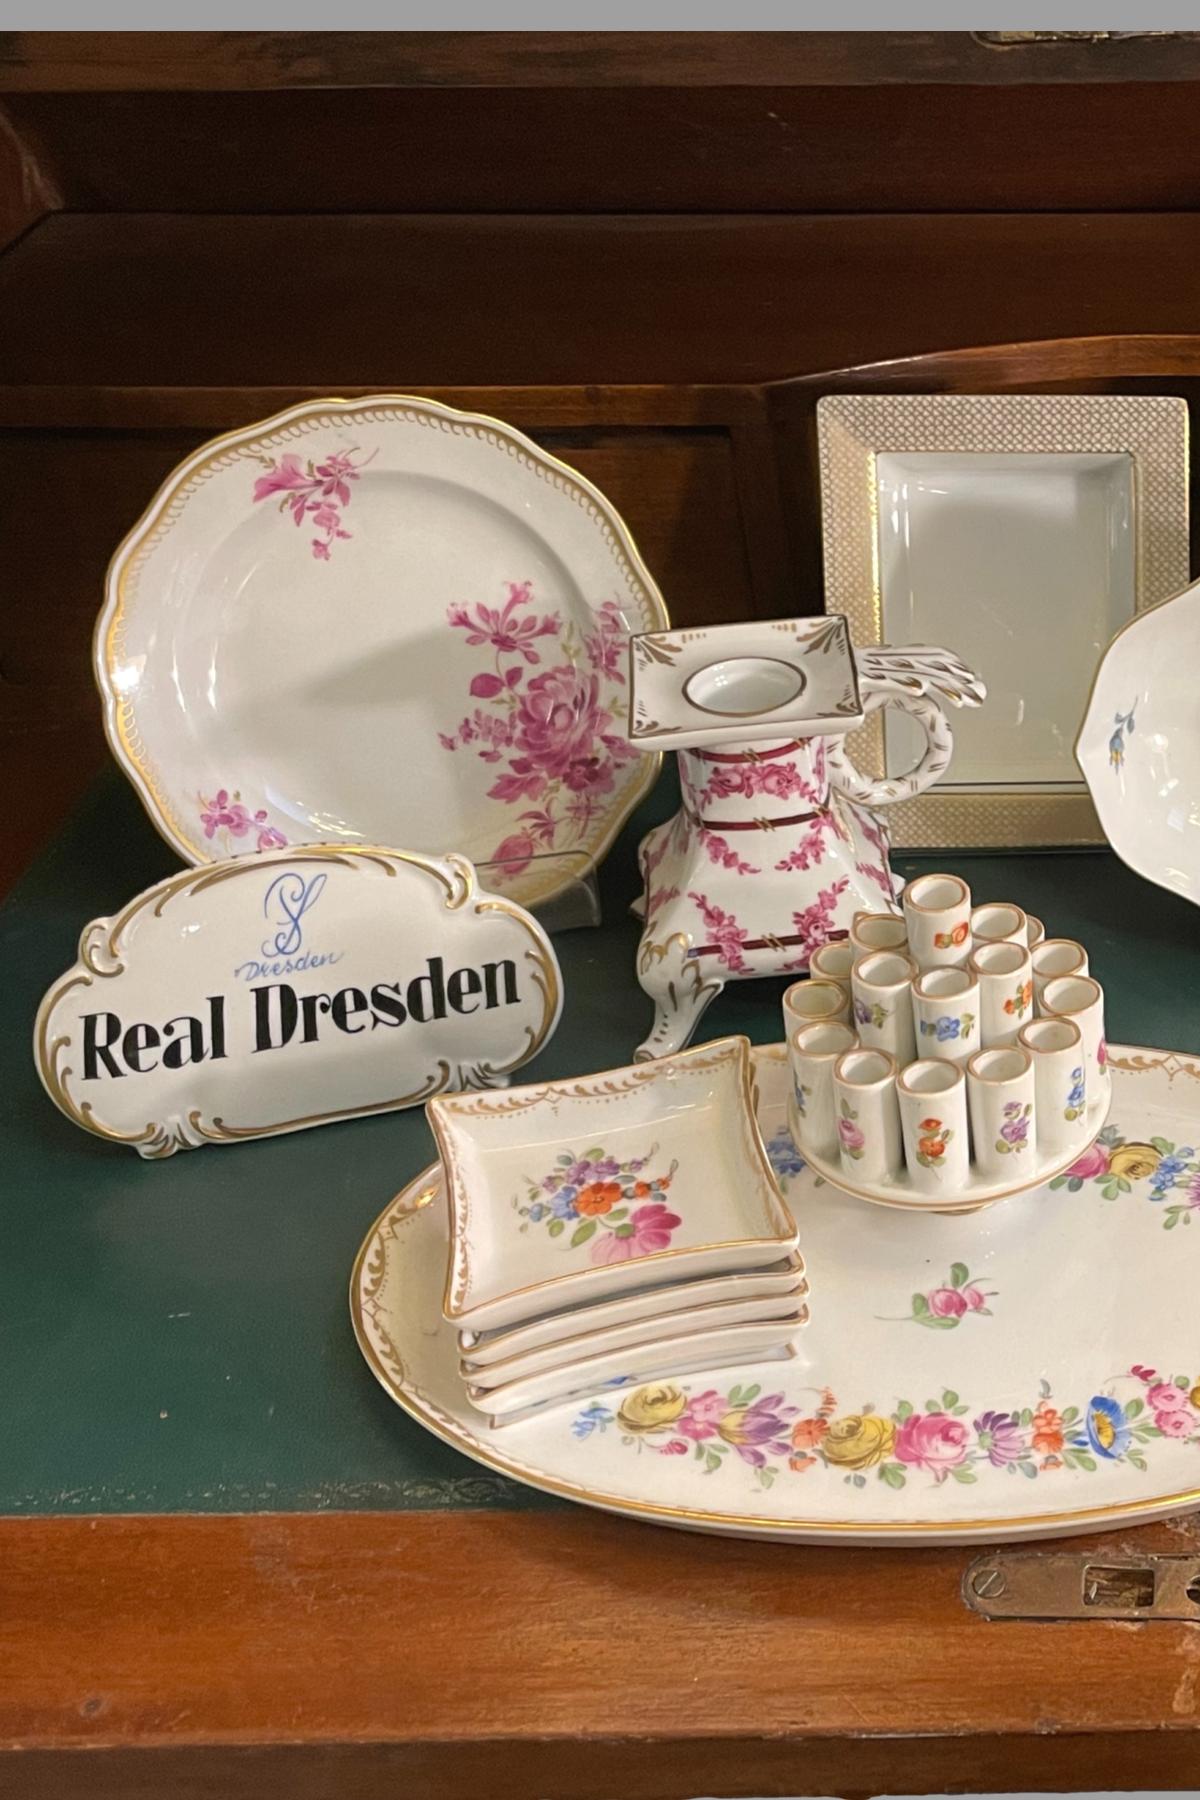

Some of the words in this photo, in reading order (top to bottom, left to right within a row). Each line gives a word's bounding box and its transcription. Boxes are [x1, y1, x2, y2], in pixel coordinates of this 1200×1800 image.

[234, 950, 345, 982] Dresden
[79, 995, 228, 1081] Real
[249, 955, 523, 1053] Dresden
